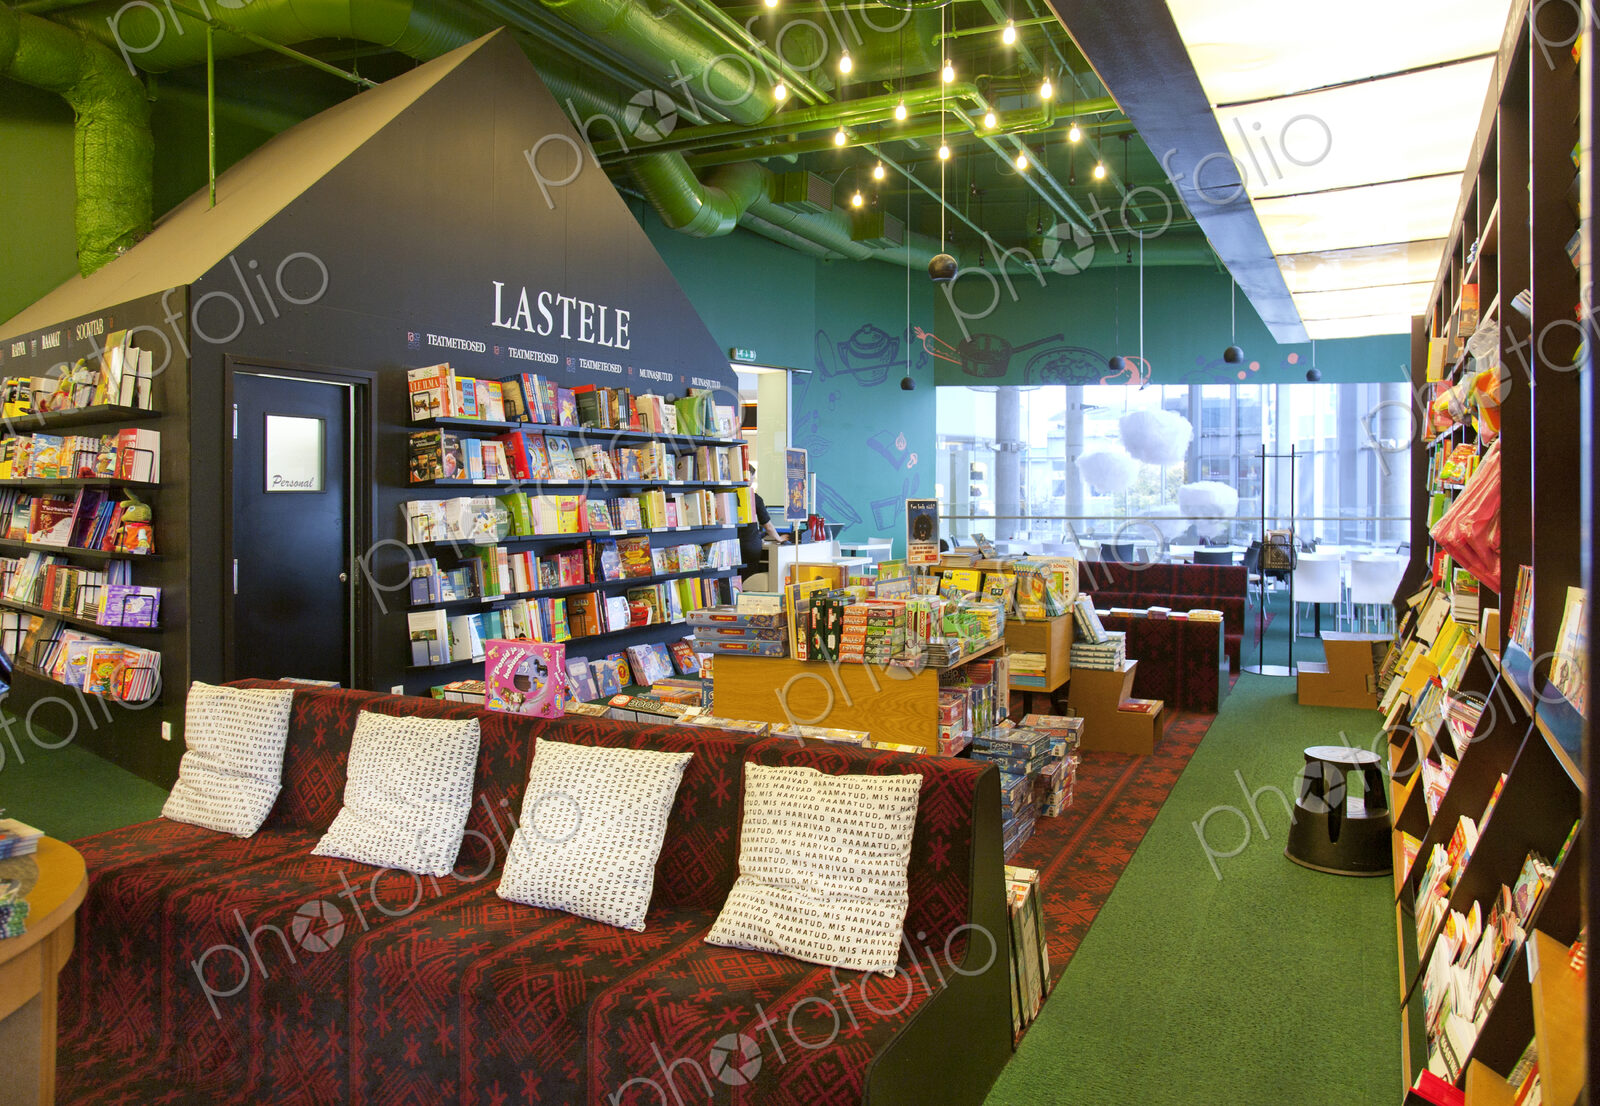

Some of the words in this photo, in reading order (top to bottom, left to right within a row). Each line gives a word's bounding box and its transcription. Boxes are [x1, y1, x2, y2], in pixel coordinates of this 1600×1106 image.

[491, 280, 631, 350] LASTELE
[426, 333, 486, 354] TEATMETEOSED
[508, 347, 559, 365] TEATMETEOSED
[579, 358, 622, 374] TEATMETEOSED
[639, 368, 673, 383] MUINASJUTUD
[272, 474, 314, 488] Personal
[494, 649, 511, 675] Ponid
[503, 648, 526, 679] hobused
[770, 776, 808, 784] HARIVAD
[813, 781, 863, 790] RAAMATUD,
[773, 783, 812, 792] HARIVAD
[817, 790, 868, 800] RAAMATUD,
[776, 792, 815, 801] HARIVAD
[820, 798, 875, 810] RAAMATUD,
[781, 801, 819, 811] HARIVAD
[825, 806, 881, 820] RAAMATUD,
[786, 811, 825, 821] HARIVAD
[830, 817, 887, 830] RAAMATUD,
[891, 822, 908, 830] MIS
[791, 821, 831, 832] HARIVAD
[836, 827, 893, 841] RAAMATUD,
[896, 831, 910, 840] MIS
[796, 832, 836, 843] HARIVAD
[842, 838, 899, 851] RAAMATUD,
[800, 841, 842, 853] HARIVAD
[792, 859, 807, 867] MIS
[812, 863, 854, 873] HARIVAD
[805, 852, 848, 863] HARIVAD
[819, 873, 863, 883] HARIVAD
[824, 882, 868, 893] HARIVAD
[770, 901, 820, 918] RAAMATUD,
[823, 912, 840, 920] MIS
[845, 915, 890, 928] HARIVAD
[840, 906, 885, 917] HARIVAD
[773, 912, 825, 929] RAAMATUD,
[828, 923, 845, 931] MIS
[850, 926, 894, 937] HARIVAD
[735, 920, 773, 936] HARIVAD
[779, 934, 835, 952] RAAMATUD,
[839, 946, 856, 954] MIS
[776, 923, 830, 941] RAAMATUD,
[834, 934, 851, 943] MIS
[856, 938, 900, 948] HARIVAD
[785, 946, 842, 964] RAAMATUD,
[843, 957, 862, 965] MIS
